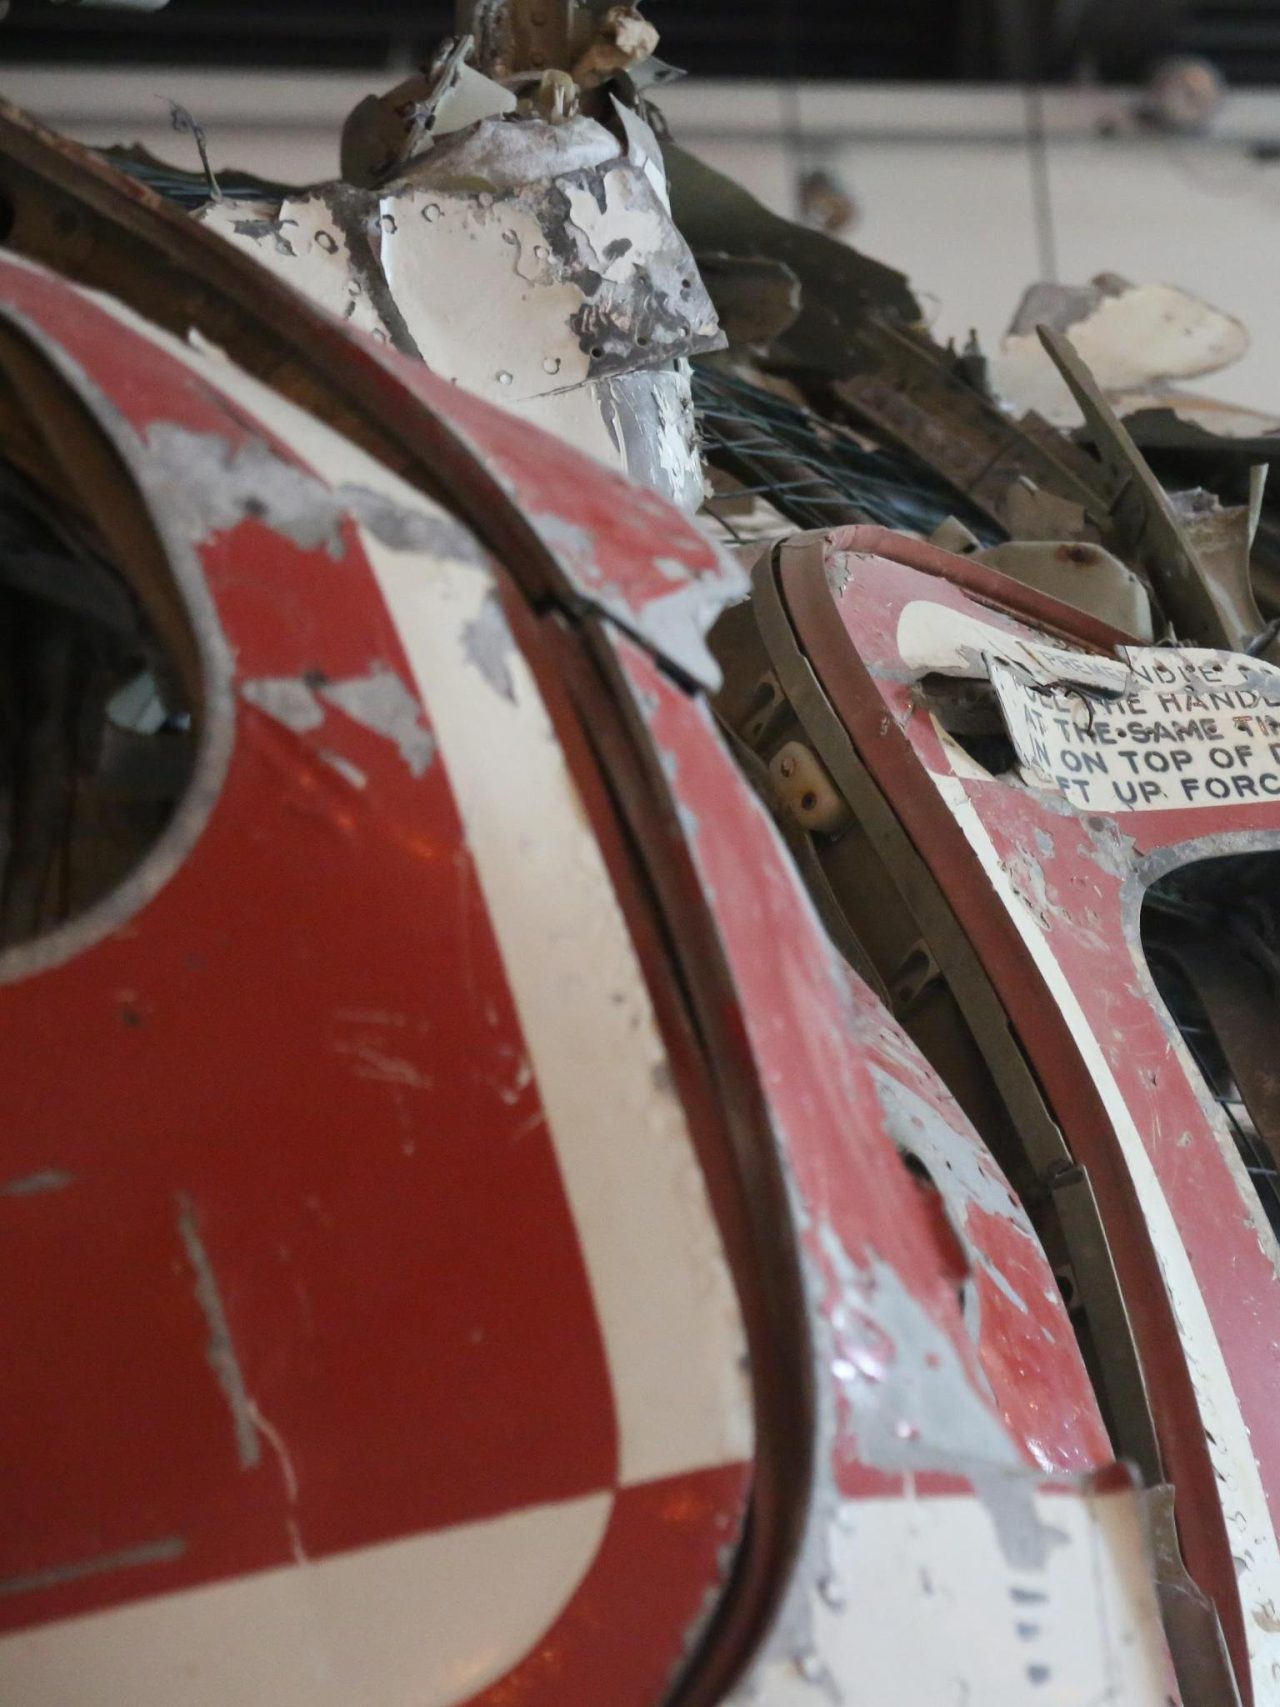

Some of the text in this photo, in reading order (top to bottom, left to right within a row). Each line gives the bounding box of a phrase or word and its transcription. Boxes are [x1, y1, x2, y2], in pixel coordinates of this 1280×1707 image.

[1053, 717, 1119, 745] THE
[1126, 717, 1225, 744] SAME
[1060, 749, 1109, 775] ON
[1117, 749, 1194, 775] TOP
[1209, 745, 1255, 769] OF
[1111, 780, 1163, 805] UP
